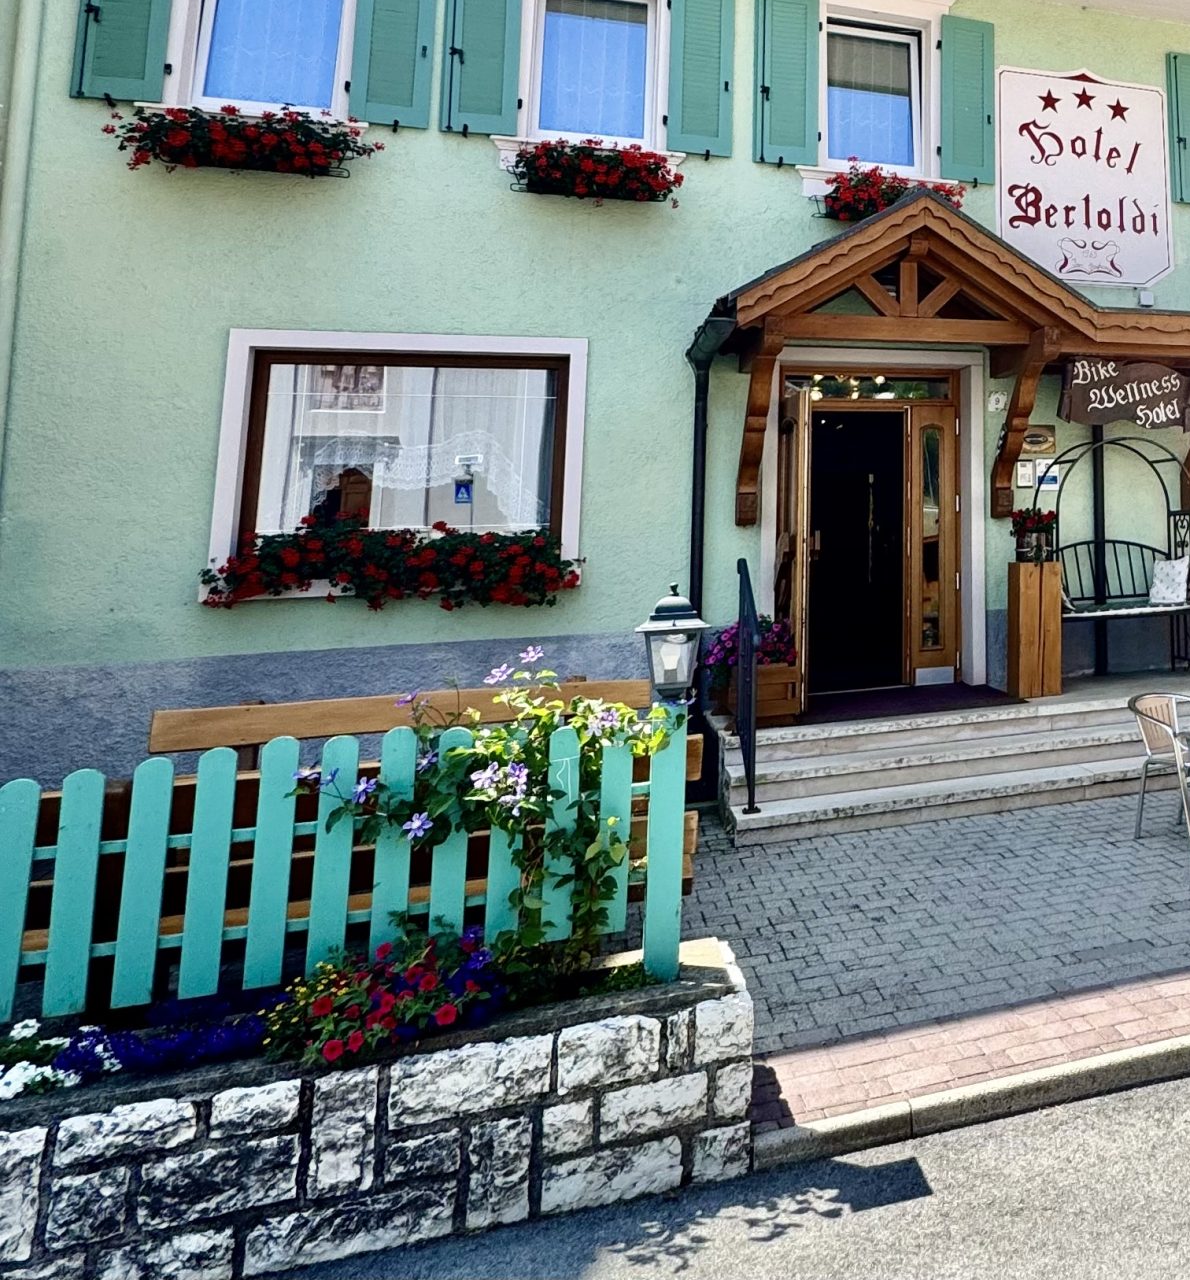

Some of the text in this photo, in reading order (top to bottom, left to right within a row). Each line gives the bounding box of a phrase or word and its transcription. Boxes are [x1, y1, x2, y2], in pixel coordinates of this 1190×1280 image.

[1018, 119, 1142, 175] Hotel
[1007, 182, 1159, 236] Bertoldi
[1072, 360, 1119, 387] Bike
[1087, 372, 1180, 412] Wellness
